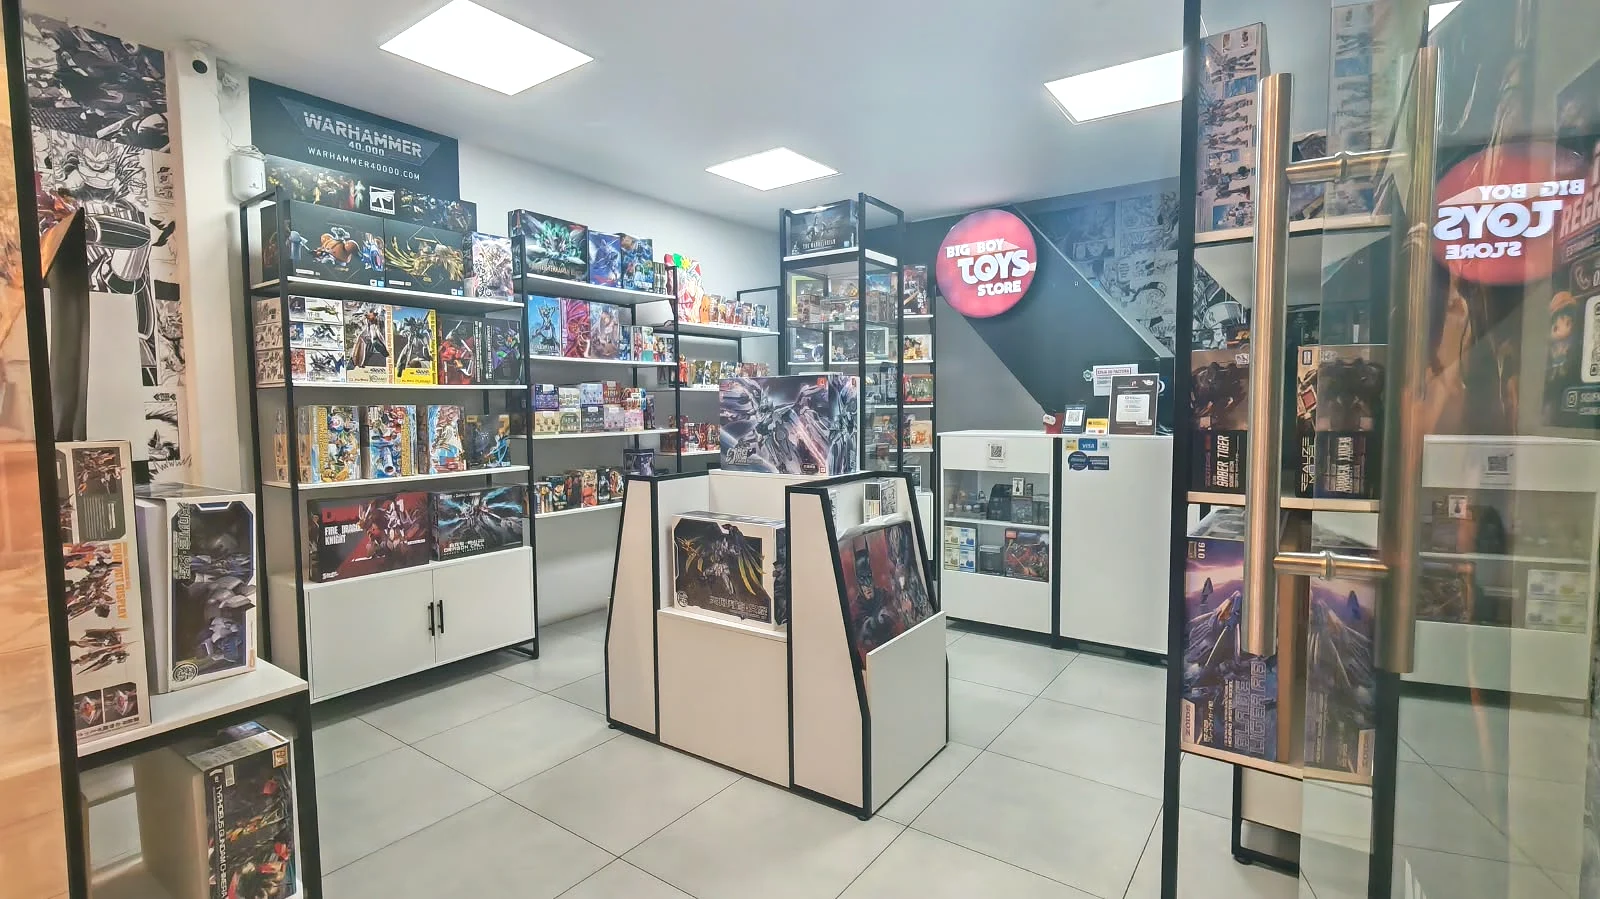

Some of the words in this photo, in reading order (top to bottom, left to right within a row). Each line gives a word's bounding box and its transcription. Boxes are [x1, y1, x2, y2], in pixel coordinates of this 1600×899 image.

[303, 111, 422, 158] WARHAMMER
[307, 146, 420, 181] WARHAMMER40000.COM
[946, 244, 971, 258] BIG
[977, 238, 1004, 253] BOY
[957, 250, 1030, 284] TOYS
[977, 280, 1022, 297] STORE
[1217, 435, 1230, 458] TIGER
[1217, 461, 1229, 487] SABER
[324, 526, 339, 536] FIRE
[324, 534, 346, 546] KNIGHT
[1198, 542, 1206, 559] 016
[1234, 679, 1250, 750] BLADE
[1250, 694, 1265, 754] LIGER
[215, 784, 225, 829] TYPHOEUS
[218, 829, 226, 863] GUNDAM
[220, 863, 228, 898] CHIMERA
